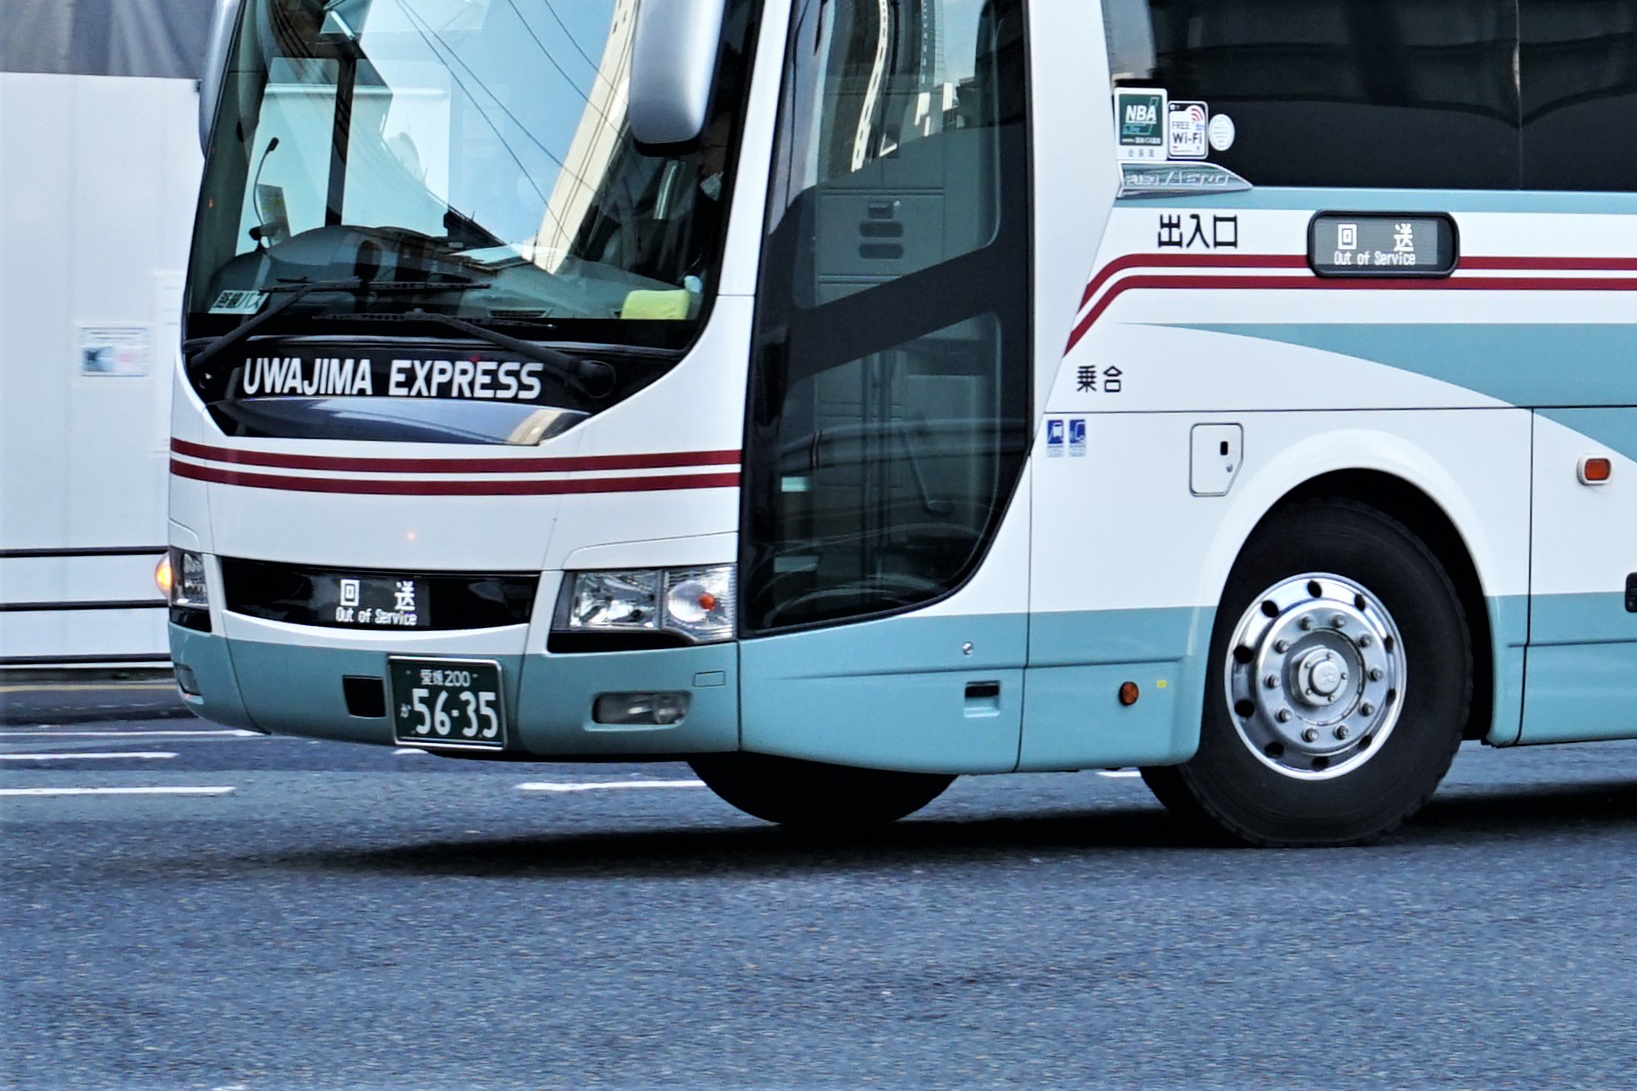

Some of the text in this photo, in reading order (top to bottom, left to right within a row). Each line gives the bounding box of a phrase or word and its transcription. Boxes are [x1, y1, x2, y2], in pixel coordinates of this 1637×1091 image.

[1125, 105, 1157, 122] NBA
[1172, 132, 1202, 144] Wi-Fi
[1157, 213, 1239, 249] 出入口
[1338, 222, 1414, 252] 回送
[1334, 250, 1416, 265] Out of Service
[243, 357, 544, 400] UWAJIMA EXPRESS
[1077, 365, 1123, 392] 乗合
[340, 579, 415, 610] 回送
[335, 607, 417, 625] Out of Service
[412, 688, 498, 738] 56-35
